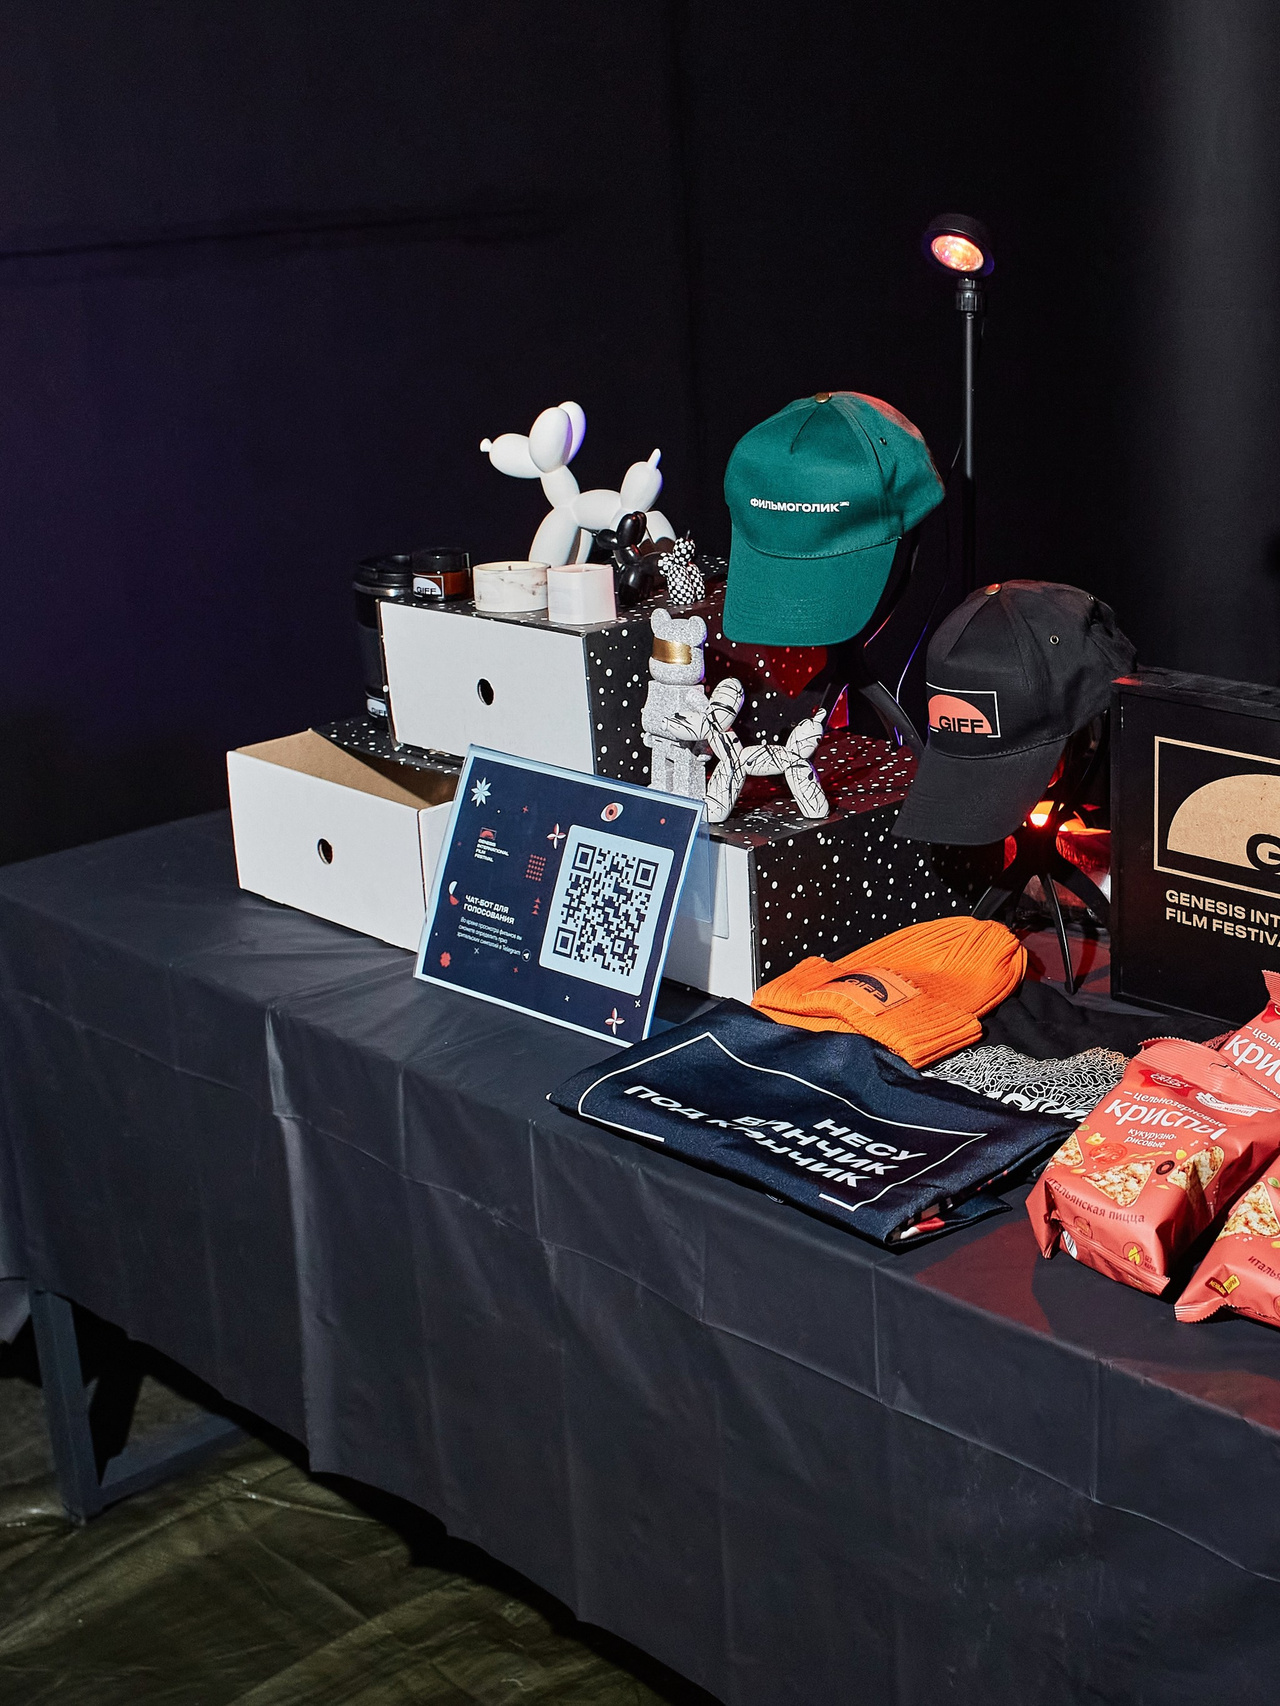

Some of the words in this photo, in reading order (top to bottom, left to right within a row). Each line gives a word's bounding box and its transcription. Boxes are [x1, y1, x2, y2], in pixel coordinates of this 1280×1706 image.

[750, 498, 840, 512] ФИЛЬМОГОЛИК
[939, 715, 984, 734] GIFF
[464, 903, 515, 925] ГОЛОСОВАНИЯ
[466, 895, 494, 909] ЧАТ-БОТ
[493, 903, 509, 913] ДЛЯ
[1165, 890, 1246, 919] GENESIS
[1165, 907, 1208, 930] FILM
[624, 1085, 709, 1120] ПОД
[1133, 1091, 1227, 1128] цельнозерновые
[1104, 1099, 1228, 1141] криспы
[732, 1116, 899, 1175] ВИНЧИК
[813, 1118, 928, 1161] НЕСУ
[1124, 1136, 1166, 1148] рисовые
[1109, 1211, 1145, 1224] пицца
